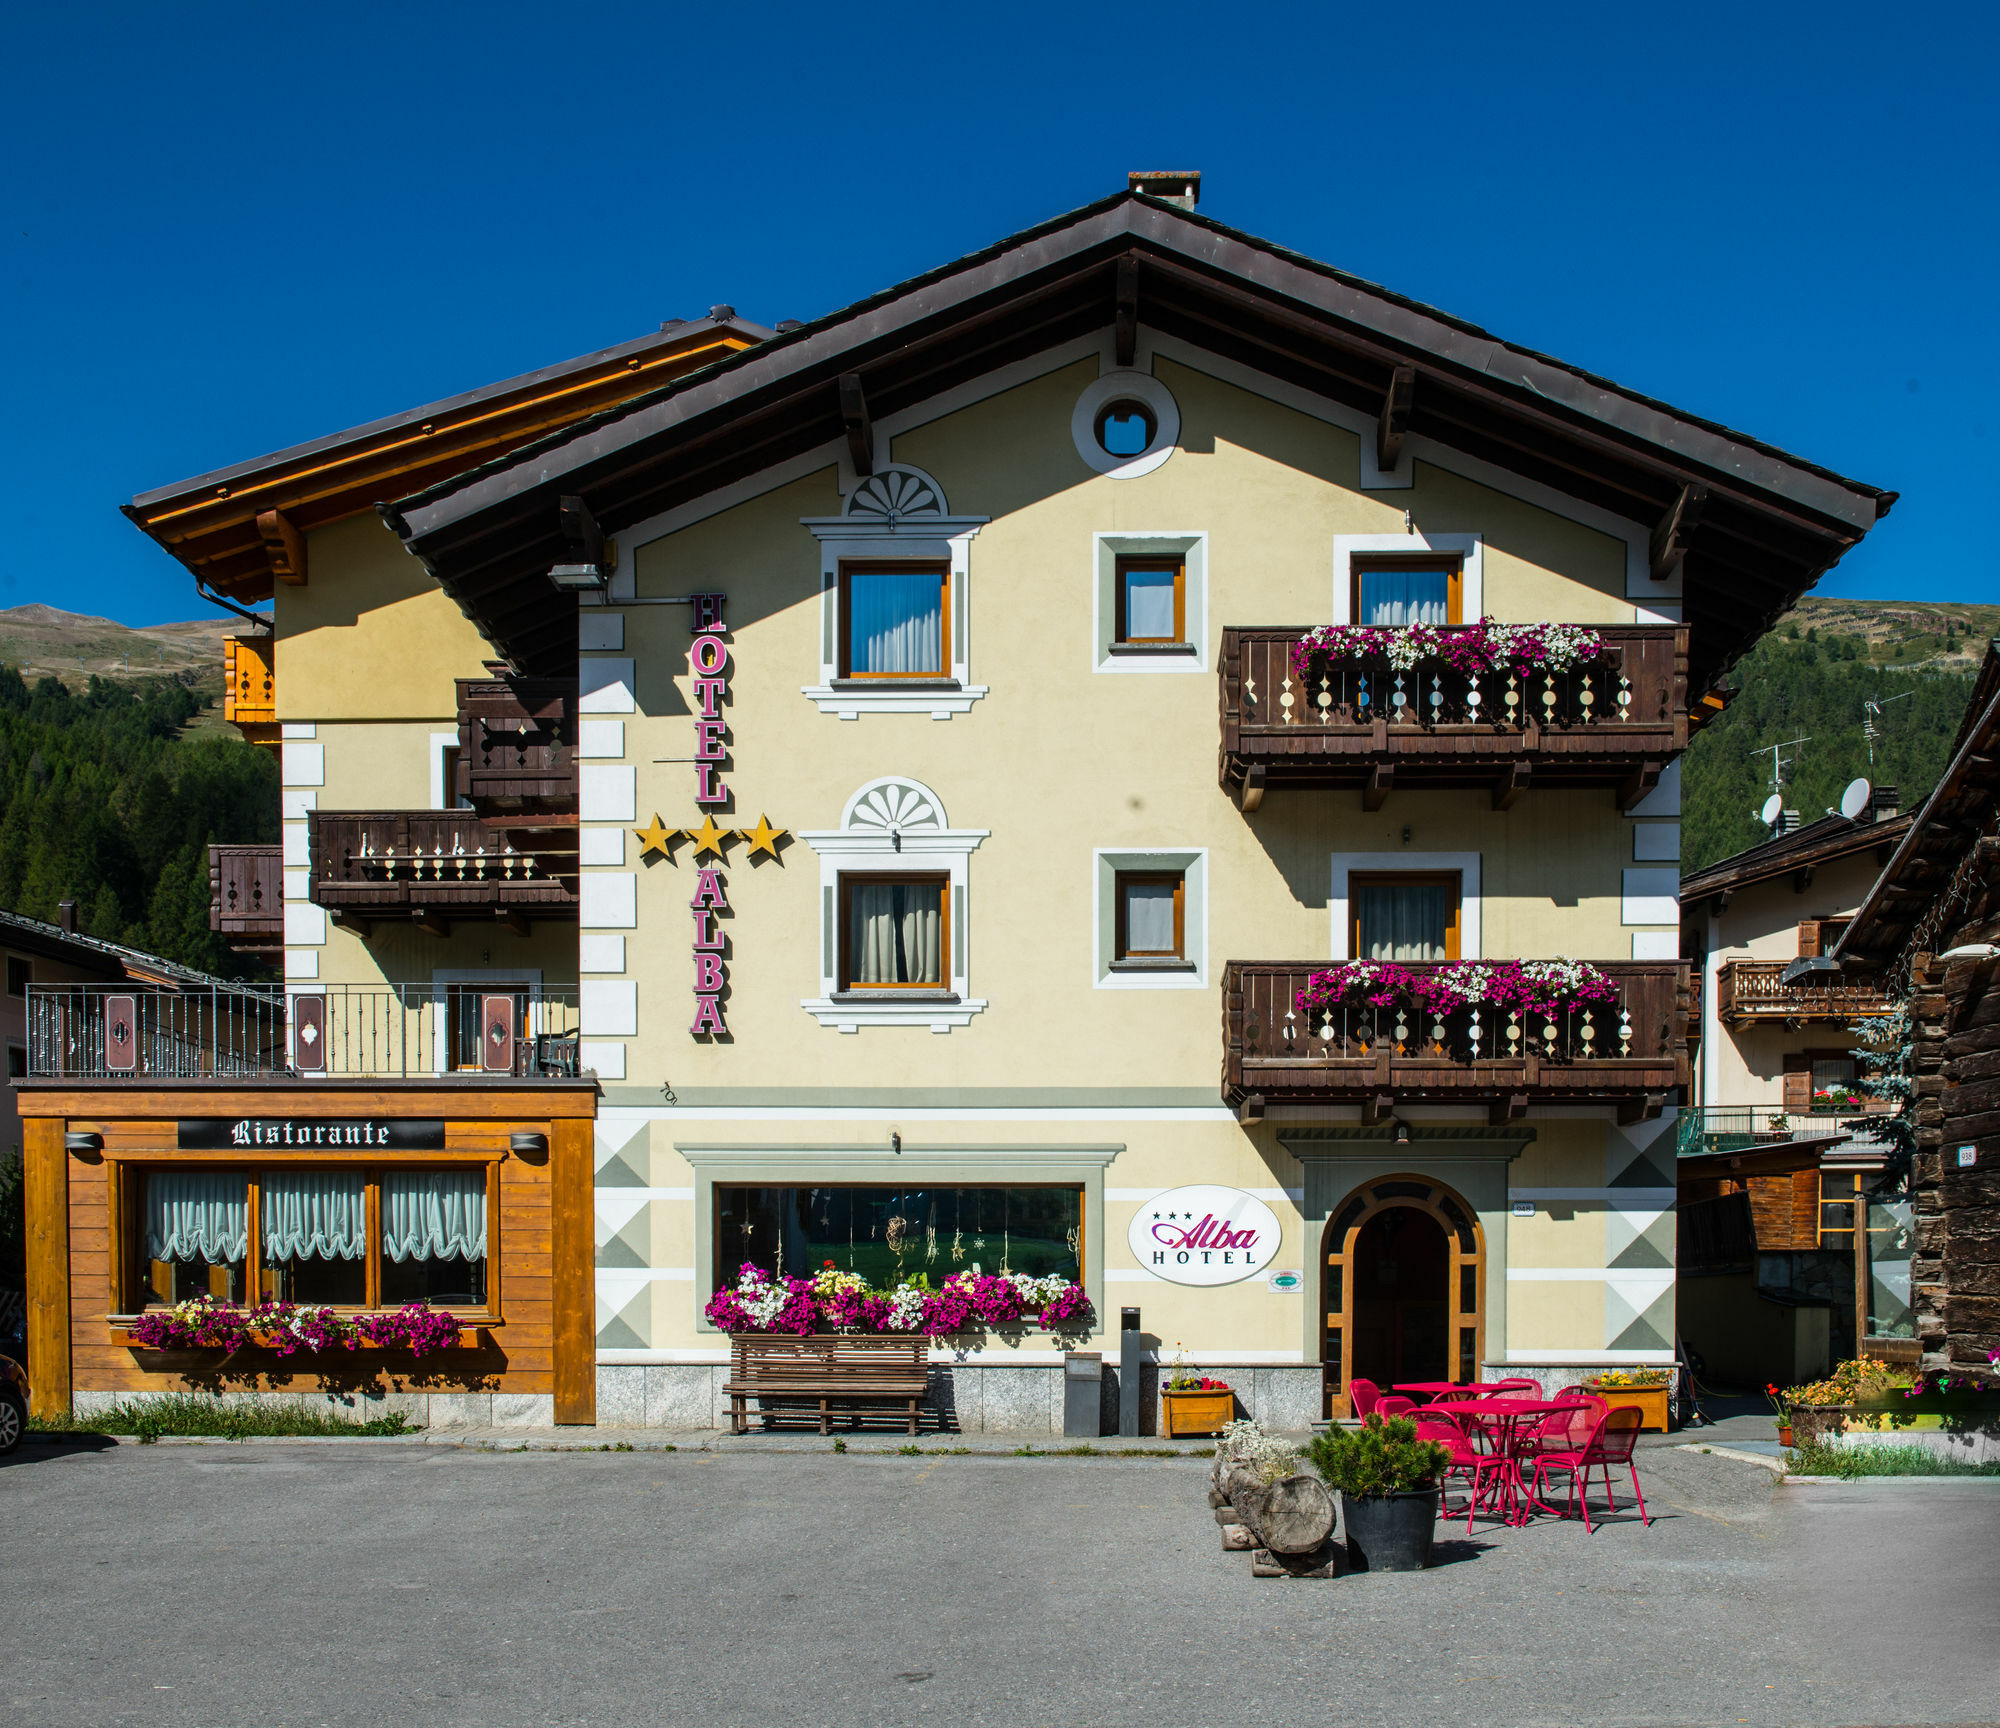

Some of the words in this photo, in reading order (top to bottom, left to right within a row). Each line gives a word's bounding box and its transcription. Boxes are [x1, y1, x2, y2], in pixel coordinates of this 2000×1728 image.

[689, 593, 727, 803] HOTEL
[689, 868, 727, 1034] ALBA
[231, 1120, 390, 1145] Ristorante
[1152, 1213, 1261, 1249] Alba
[1152, 1251, 1256, 1265] HOTEL
